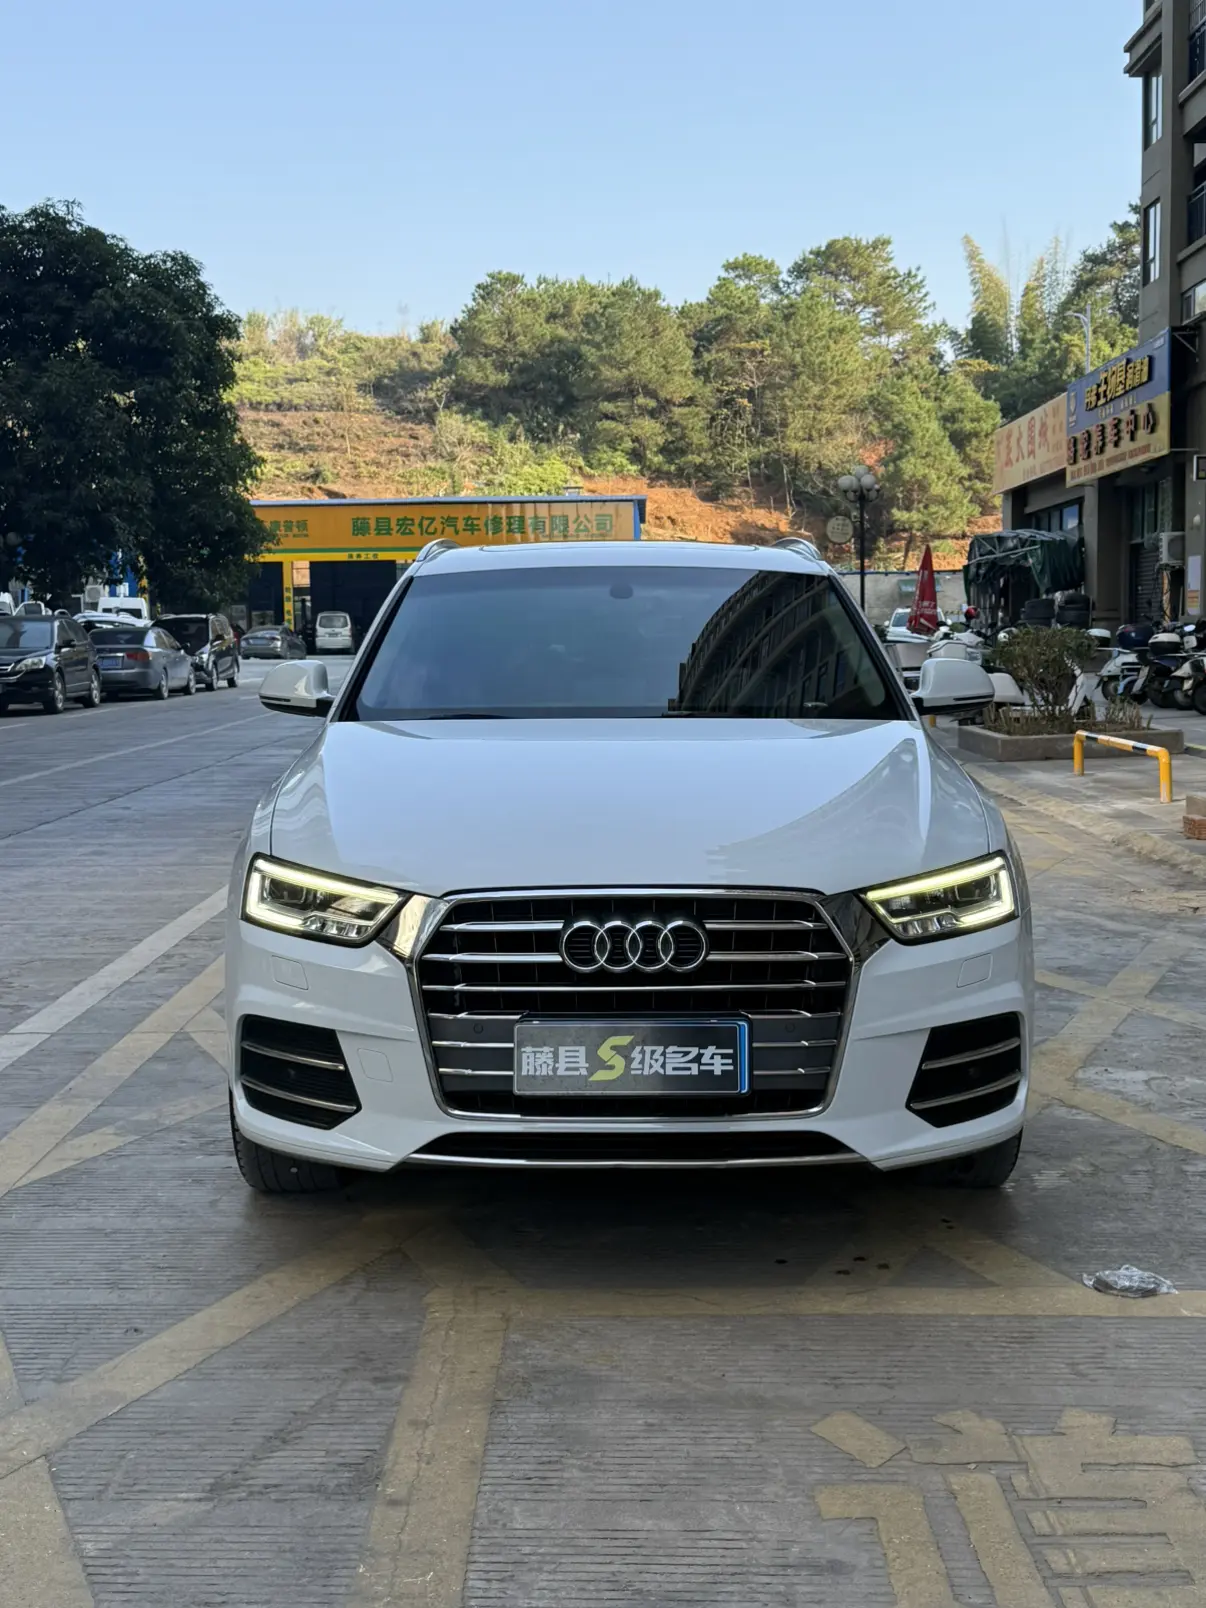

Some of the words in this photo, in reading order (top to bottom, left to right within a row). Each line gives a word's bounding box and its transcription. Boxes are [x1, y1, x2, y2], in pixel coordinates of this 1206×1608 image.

[351, 514, 613, 537] 藤县宏亿汽车修理有限公司
[520, 1035, 734, 1081] 藤县S级名车
